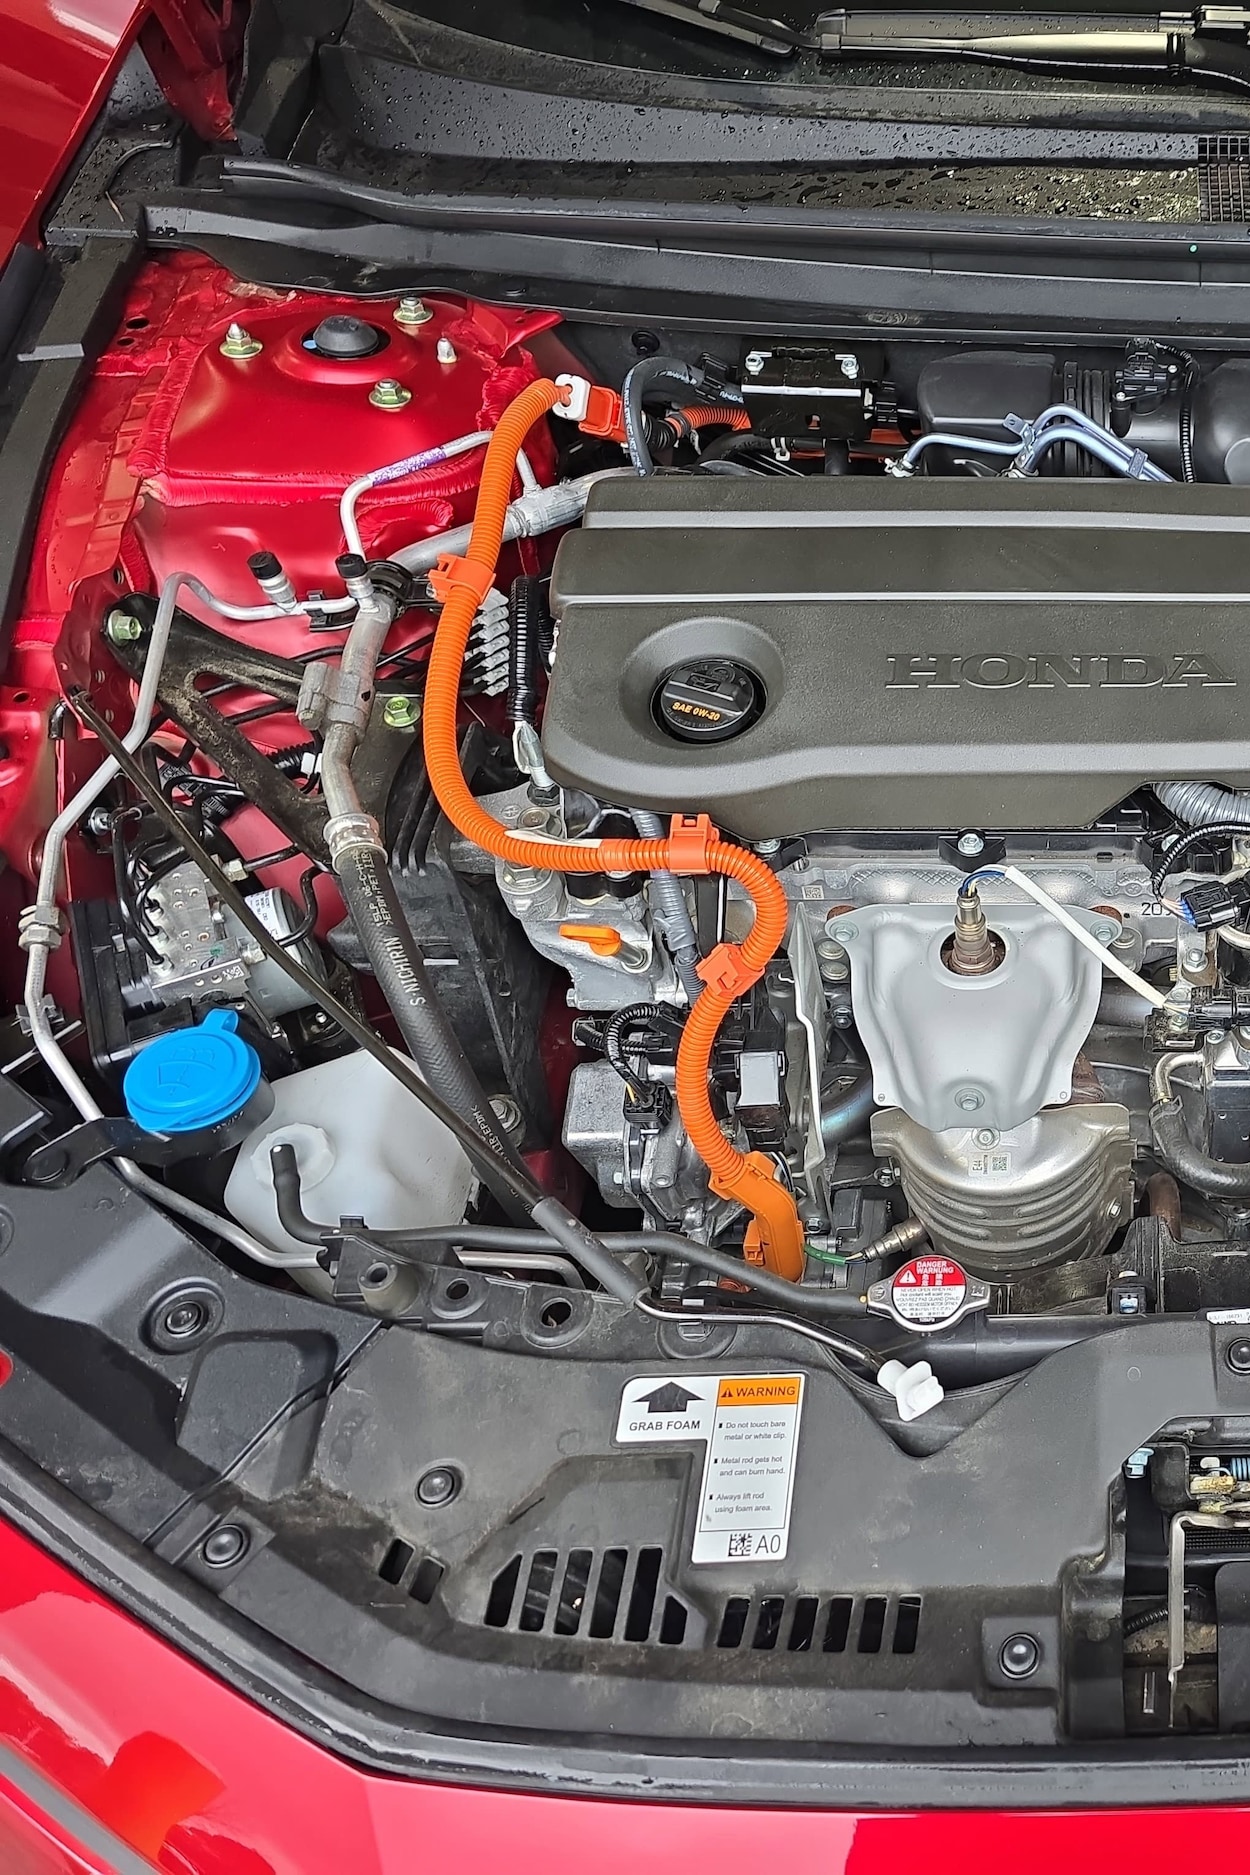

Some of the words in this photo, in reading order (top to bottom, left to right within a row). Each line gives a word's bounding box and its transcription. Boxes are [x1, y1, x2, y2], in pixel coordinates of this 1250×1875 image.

[885, 653, 1237, 689] HONDA
[672, 701, 692, 713] SAE
[693, 707, 721, 721] 0W-20
[916, 1266, 954, 1274] WARNUNG
[736, 1386, 795, 1397] WARNING
[629, 1421, 663, 1431] GRAB
[666, 1420, 700, 1430] FOAM
[773, 1432, 787, 1440] clip.
[754, 1457, 769, 1465] gets
[716, 1493, 741, 1501] Always
[755, 1534, 781, 1554] A0
